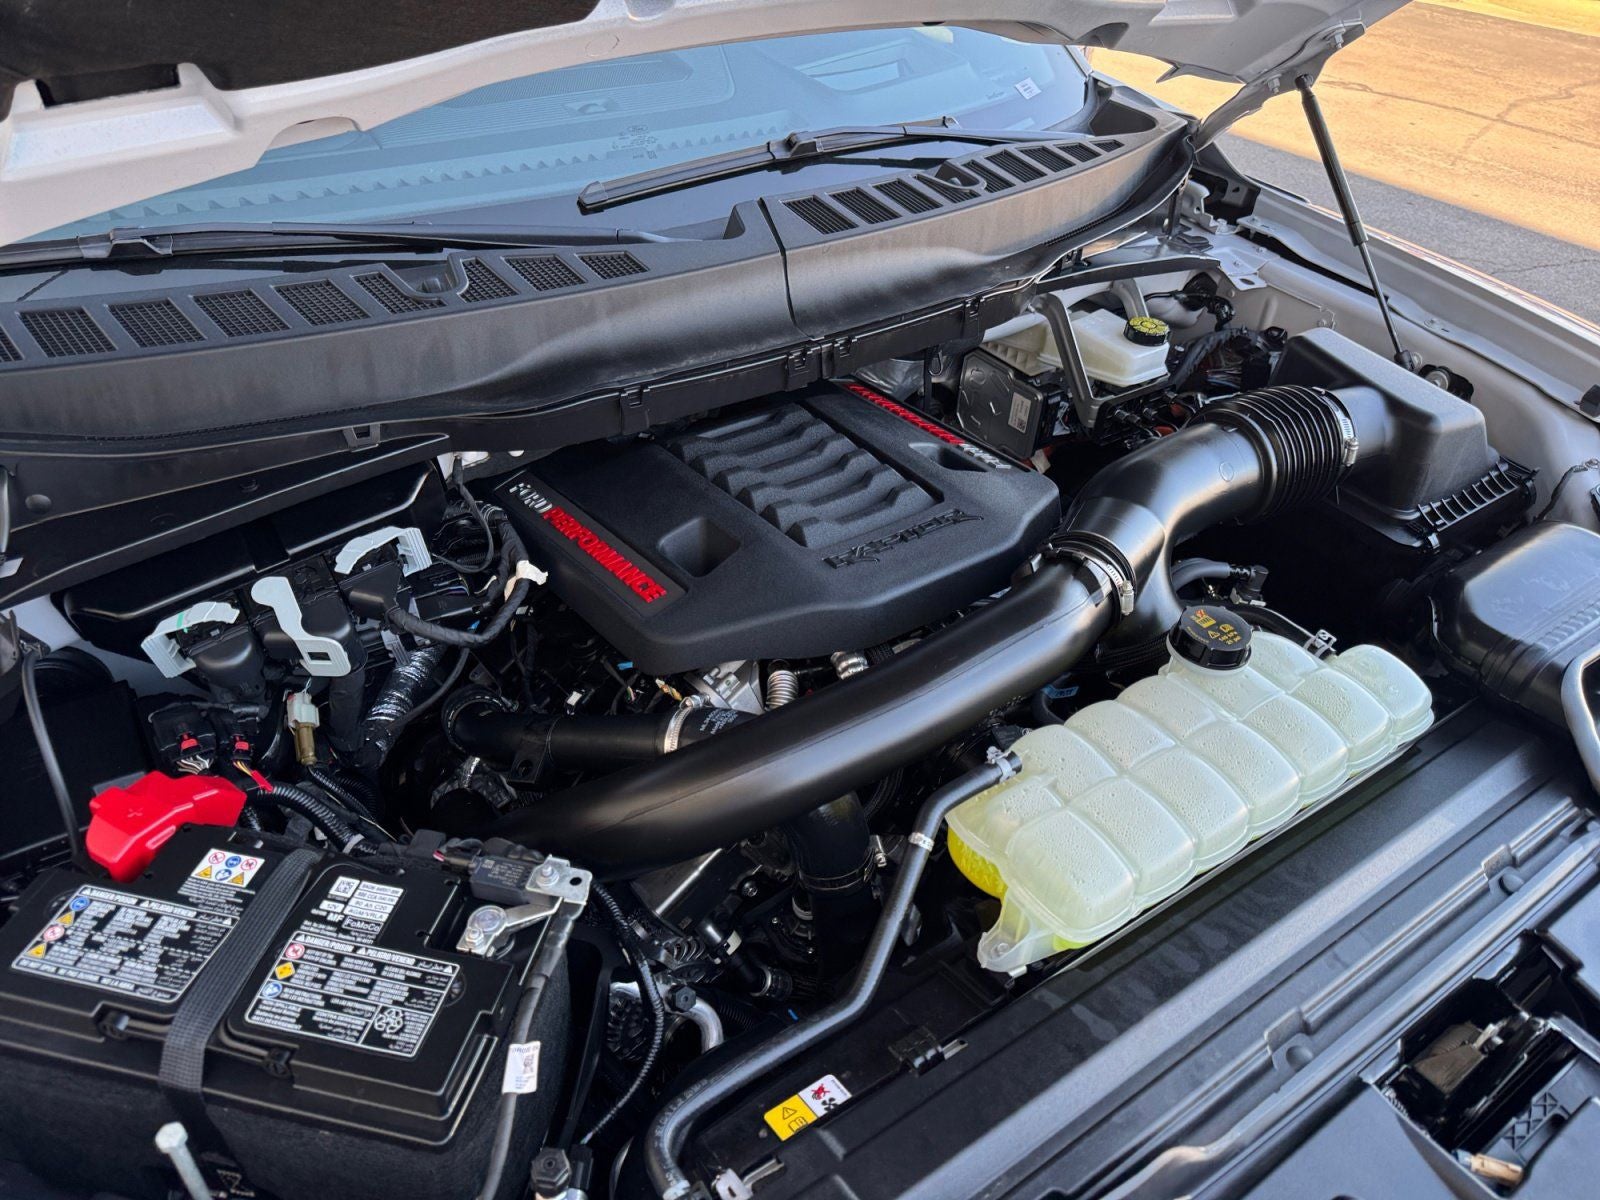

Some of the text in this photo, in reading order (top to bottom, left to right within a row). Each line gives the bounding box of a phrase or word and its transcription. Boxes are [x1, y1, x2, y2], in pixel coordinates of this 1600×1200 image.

[509, 482, 668, 603] FORD PERFORMANCE
[821, 508, 984, 569] RAPTOR
[346, 918, 381, 932] FoMoCo
